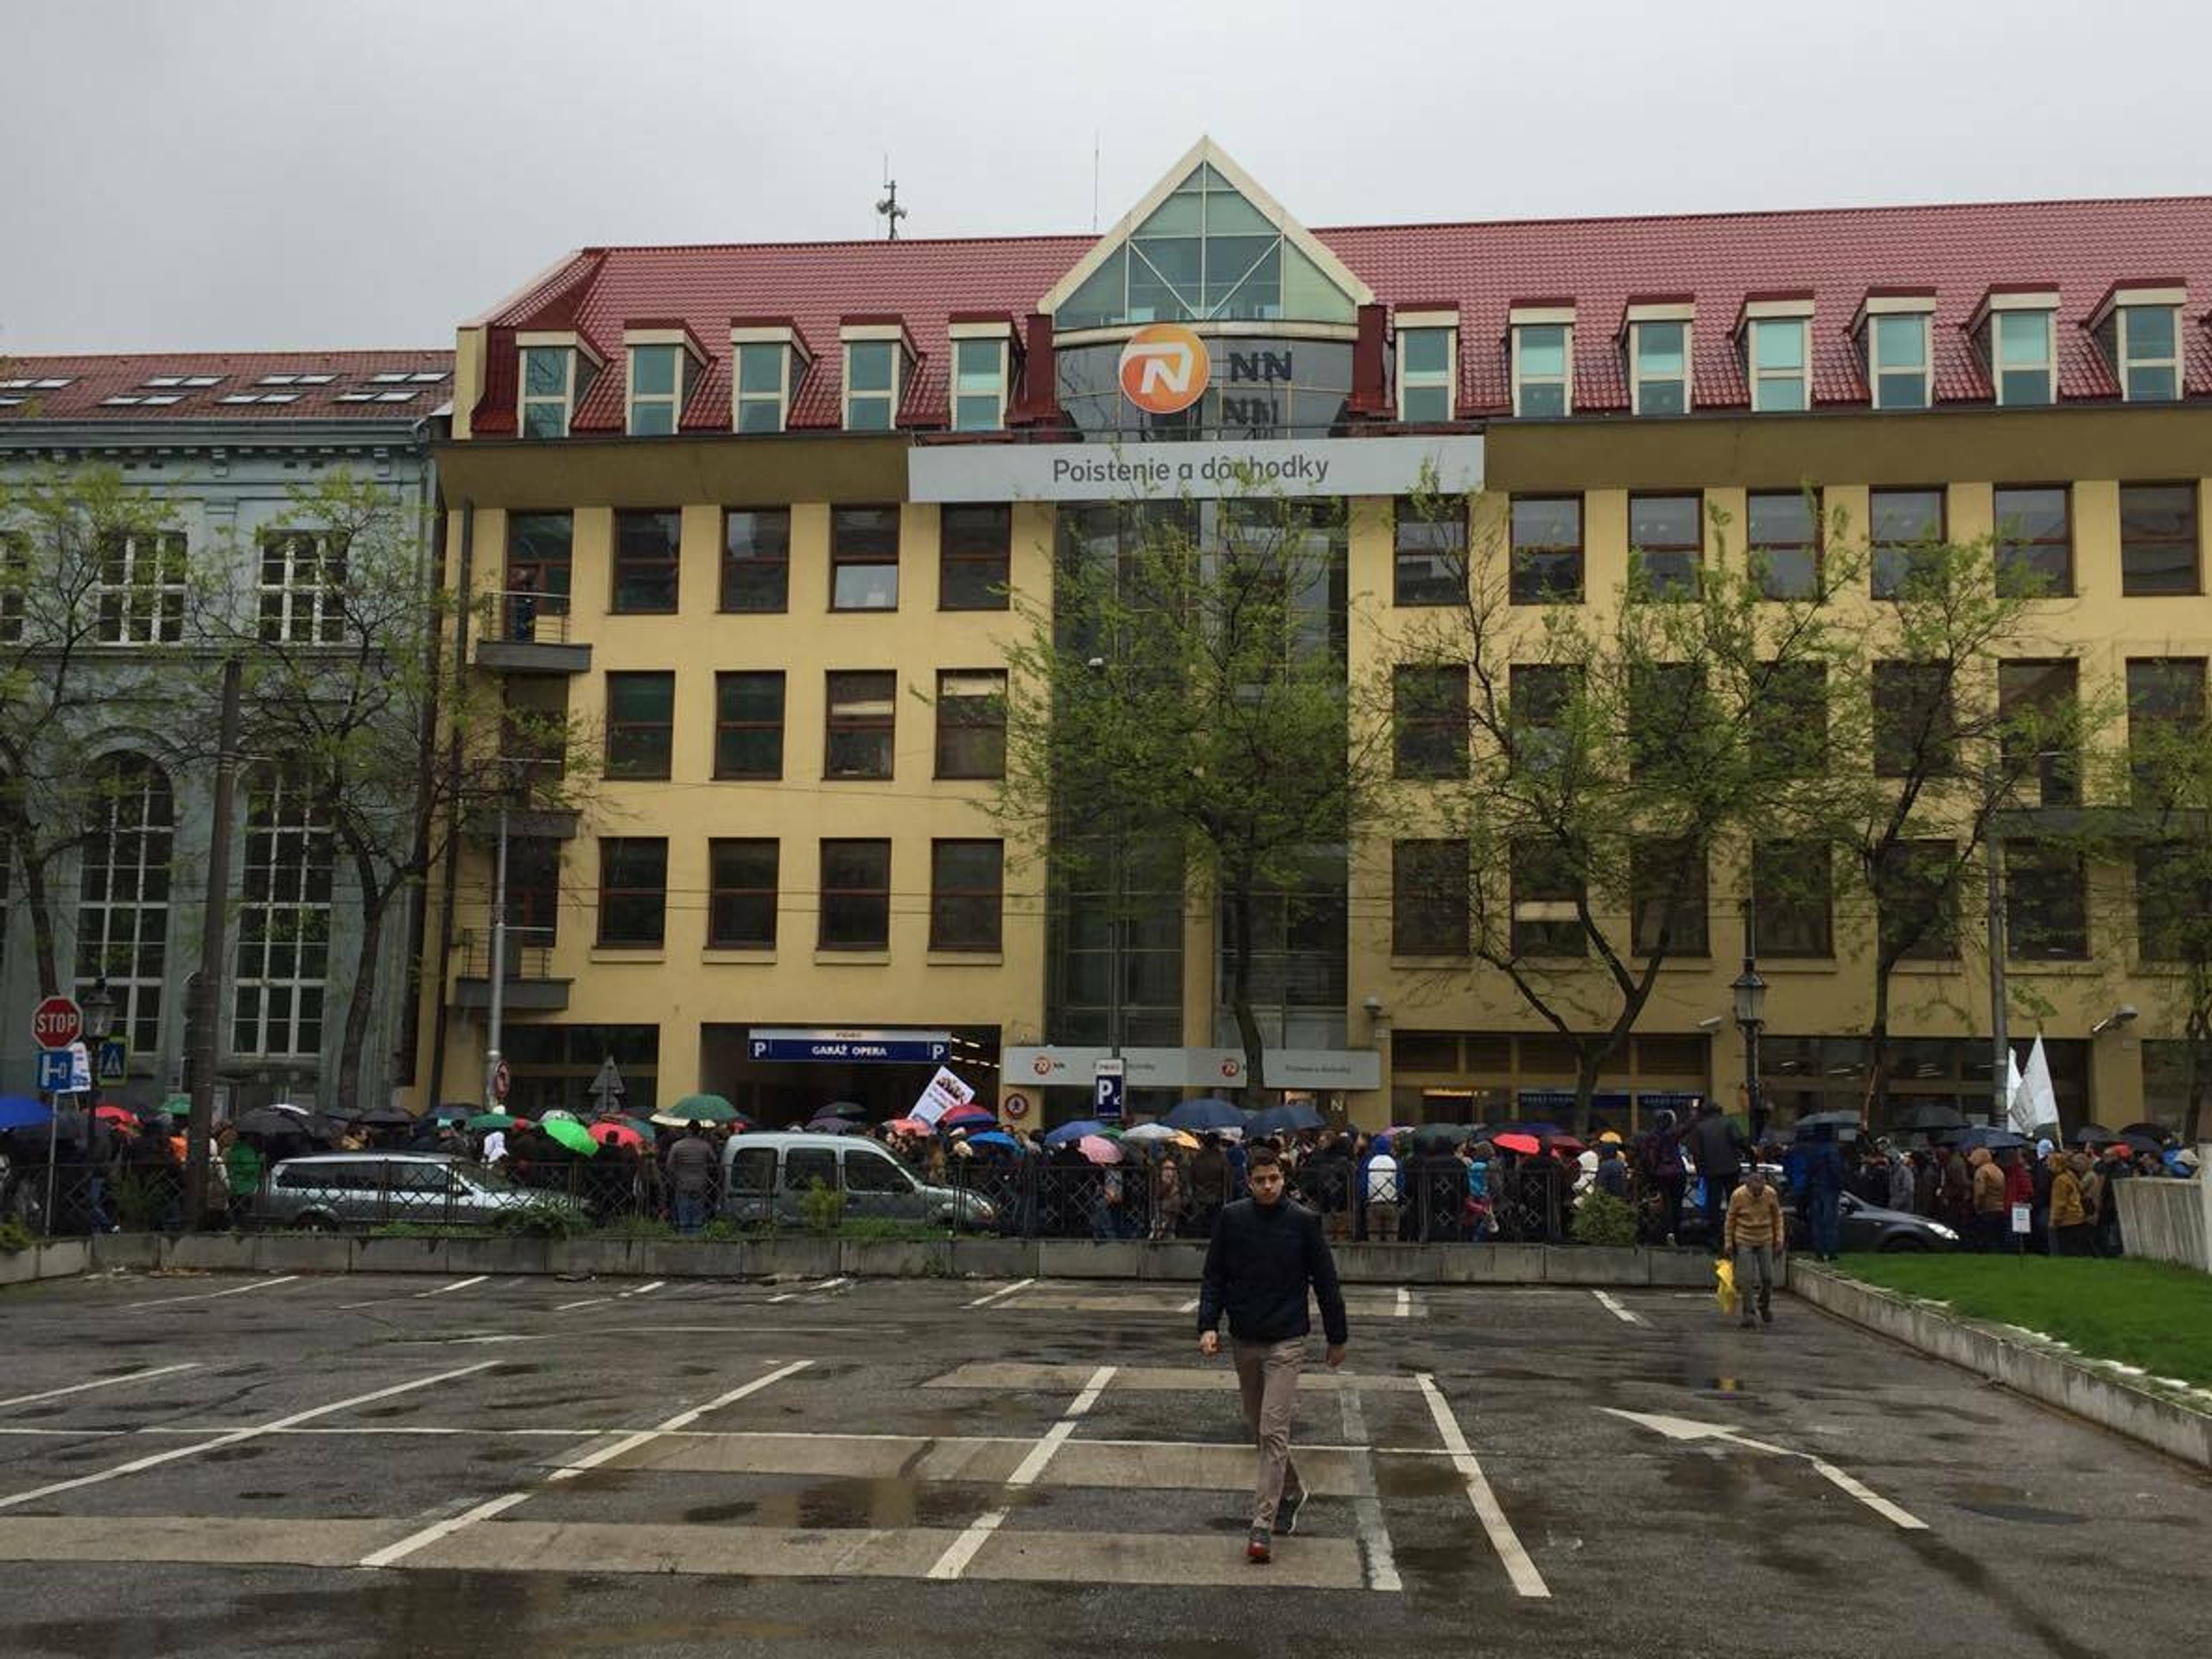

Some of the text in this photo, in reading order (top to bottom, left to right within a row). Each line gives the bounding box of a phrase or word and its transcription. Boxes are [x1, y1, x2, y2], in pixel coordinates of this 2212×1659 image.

[1228, 351, 1293, 382] NN
[1052, 454, 1330, 483] Poistenie a dôchodky
[36, 1013, 78, 1033] STOP
[753, 1041, 767, 1058] P
[811, 1044, 888, 1056] GARÁŽ OPERA
[932, 1044, 945, 1059] P
[1098, 1079, 1114, 1105] P
